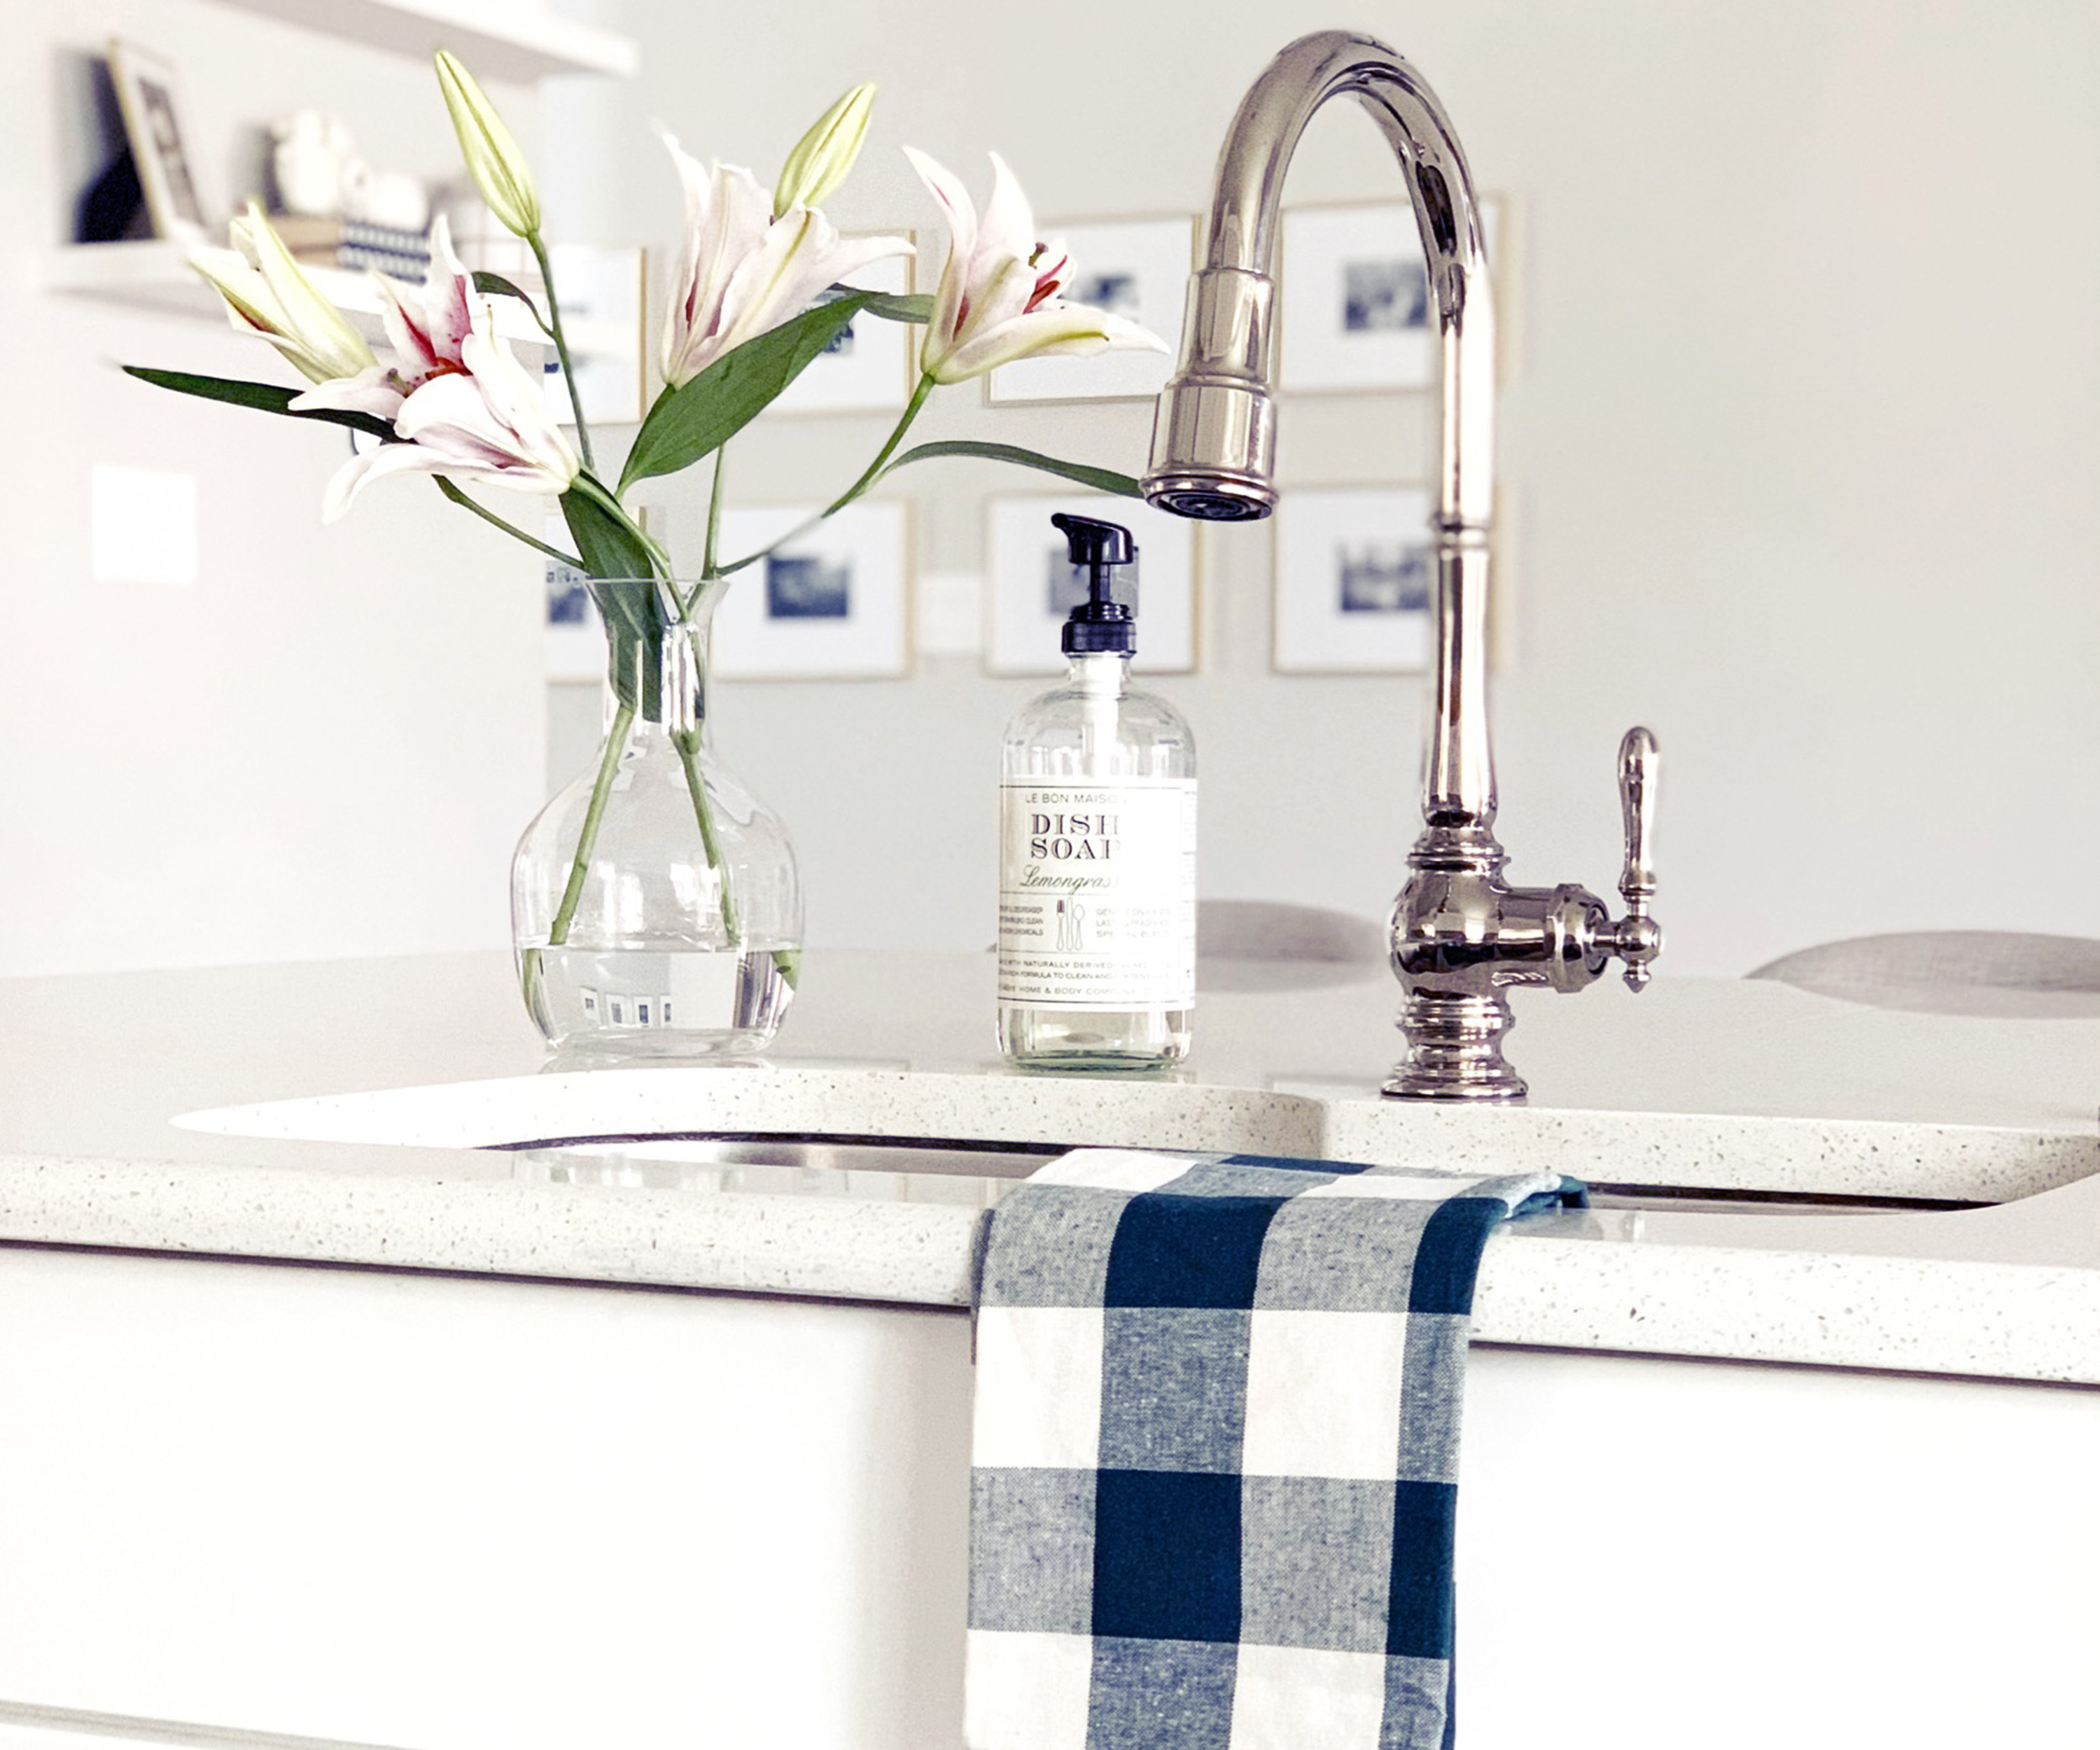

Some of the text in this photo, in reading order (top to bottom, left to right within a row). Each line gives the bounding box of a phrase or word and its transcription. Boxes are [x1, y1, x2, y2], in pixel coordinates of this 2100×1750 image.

[1025, 793, 1038, 804] LE
[1042, 793, 1069, 804] BON
[1030, 813, 1119, 836] DISH
